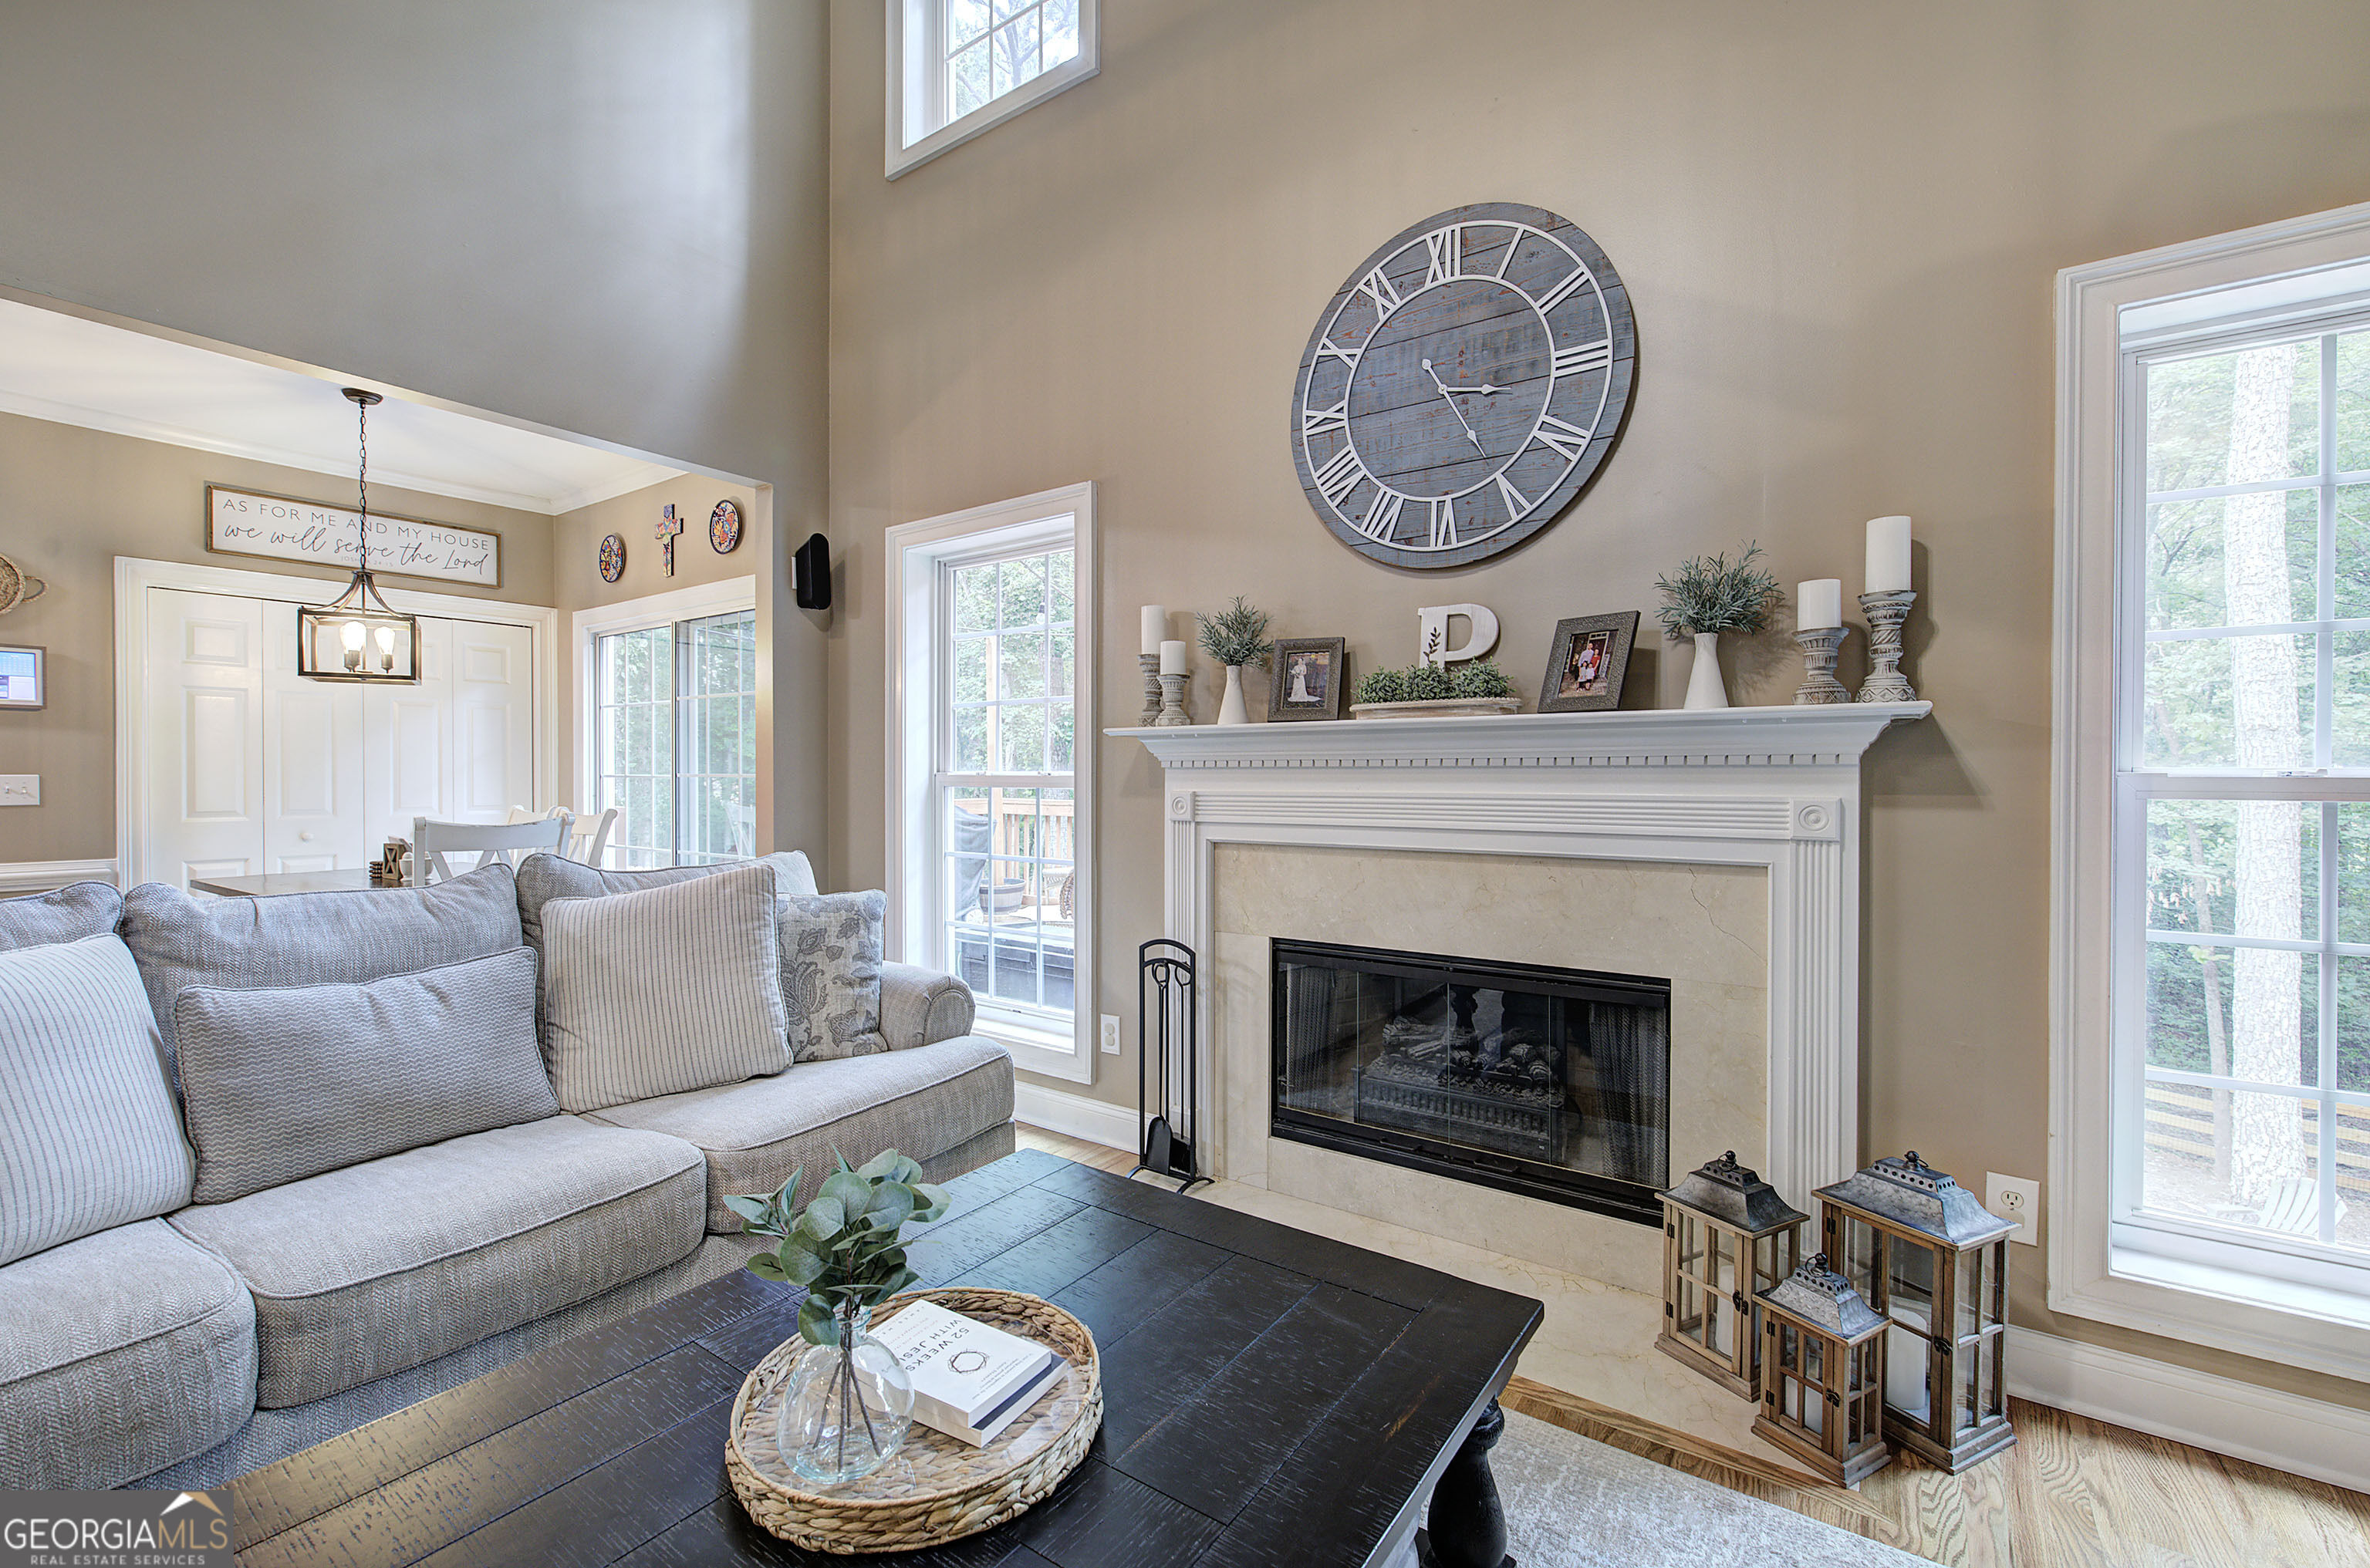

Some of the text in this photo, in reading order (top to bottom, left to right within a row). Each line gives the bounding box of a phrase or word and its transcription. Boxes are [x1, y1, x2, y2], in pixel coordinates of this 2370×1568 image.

[223, 498, 489, 551] AS FOR ME AND MY HOUSE
[223, 524, 489, 575] we will serve the Lord
[340, 555, 371, 565] JOSHA
[1418, 603, 1499, 673] P
[929, 1319, 963, 1340] WITH
[951, 1327, 970, 1340] 52
[905, 1339, 954, 1372] WEEKS
